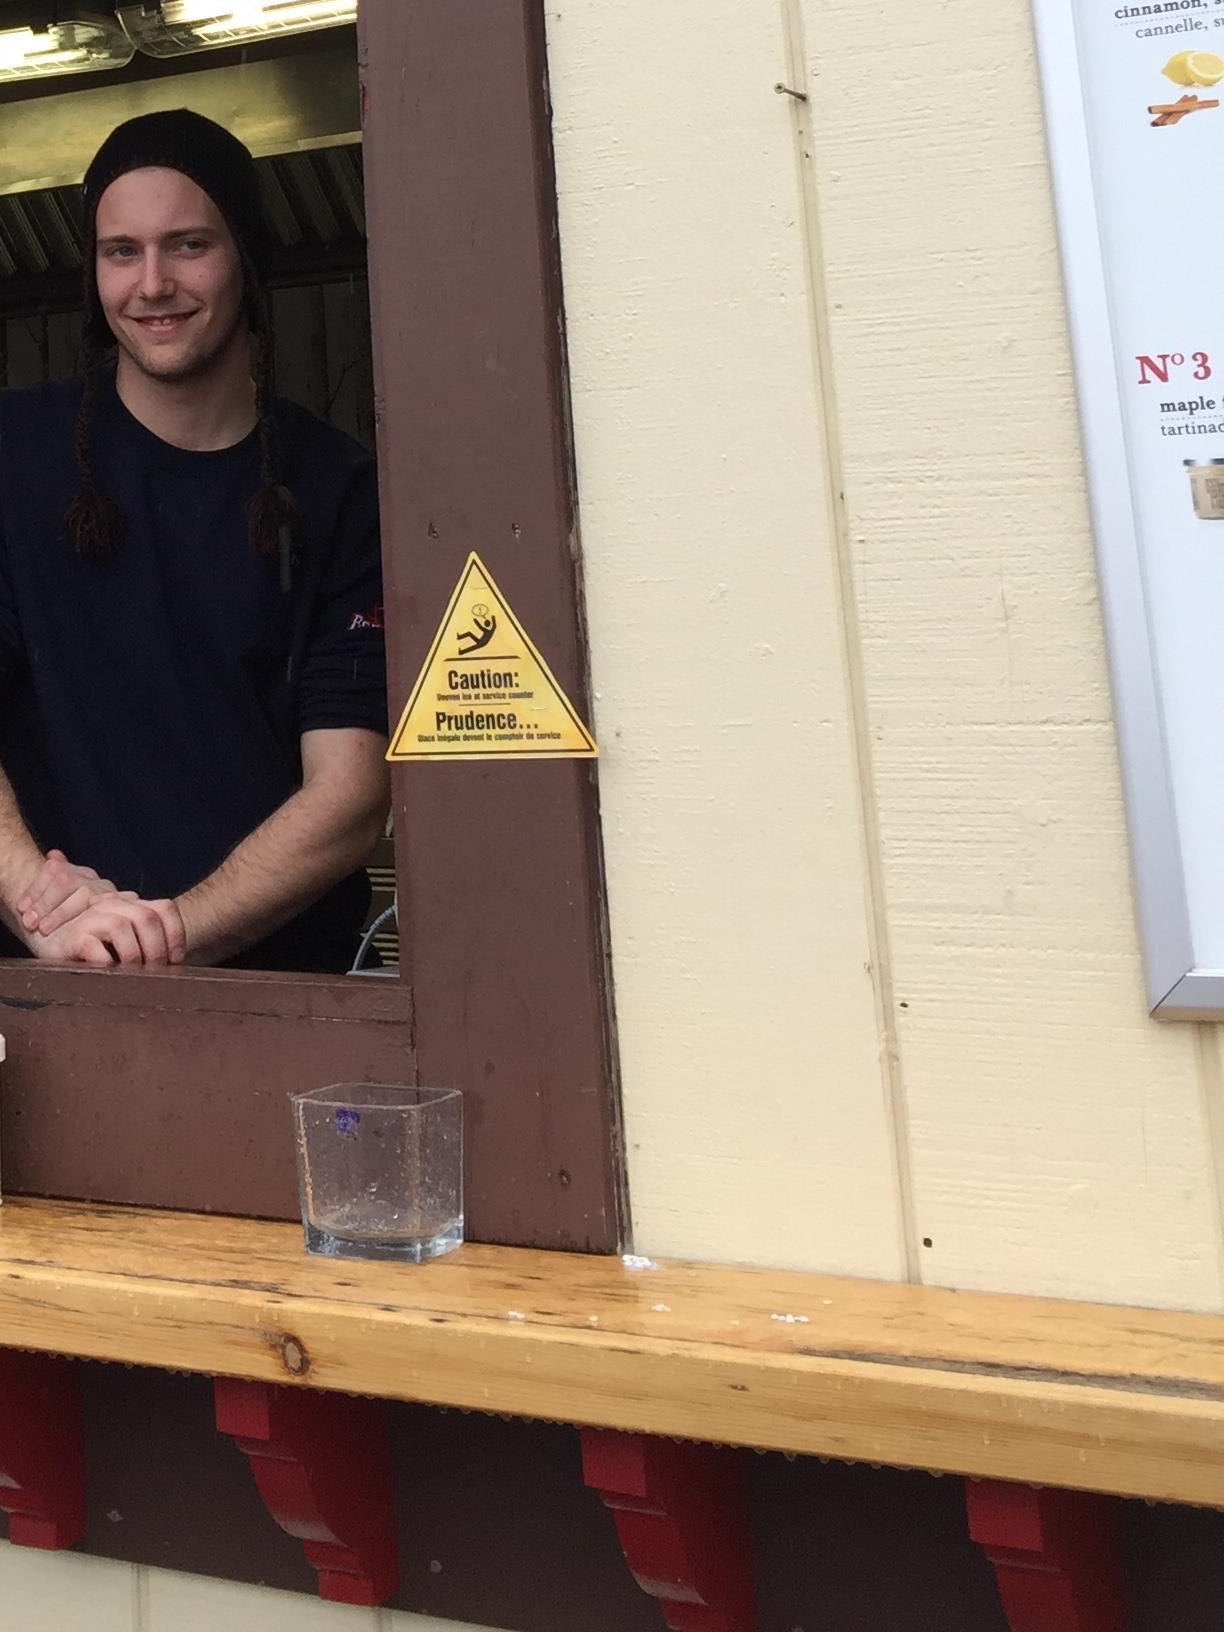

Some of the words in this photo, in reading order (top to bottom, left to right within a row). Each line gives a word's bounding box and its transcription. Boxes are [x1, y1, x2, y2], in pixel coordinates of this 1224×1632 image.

[1135, 17, 1208, 39] cannelle,
[1191, 351, 1212, 381] 3
[1160, 395, 1217, 416] maple
[448, 669, 519, 690] Caution:
